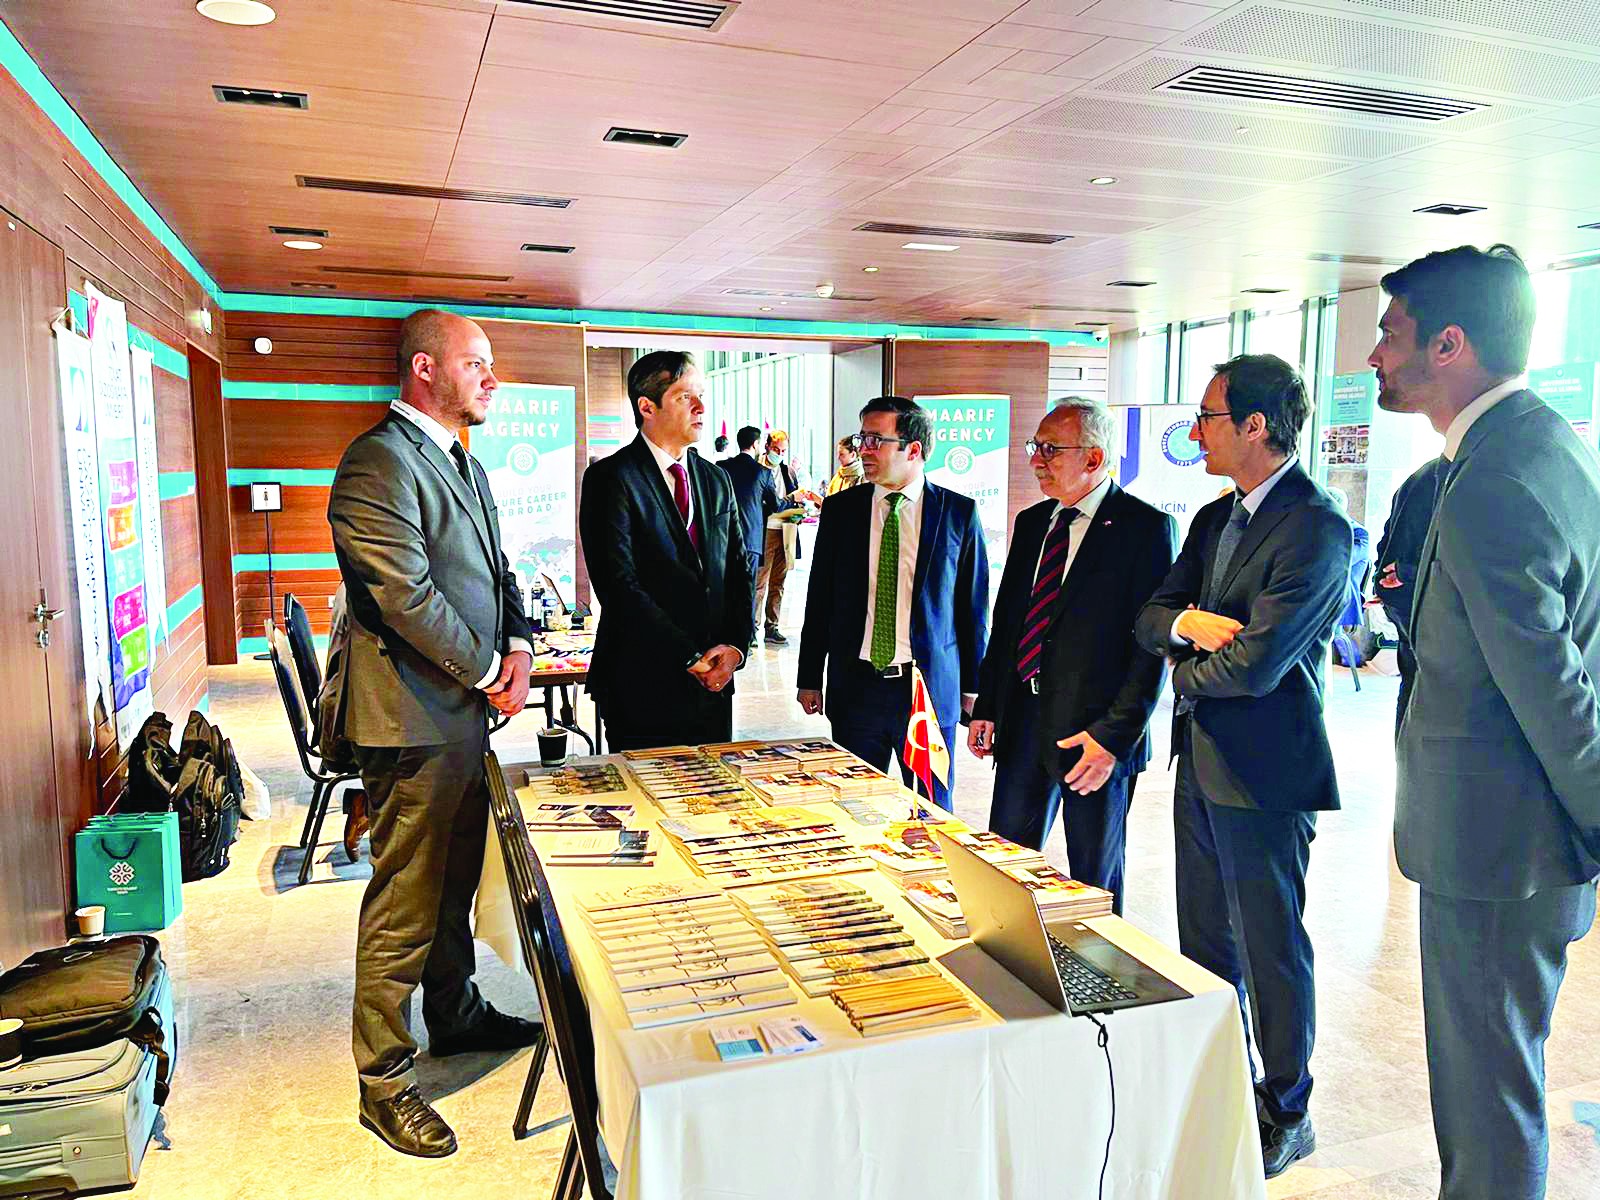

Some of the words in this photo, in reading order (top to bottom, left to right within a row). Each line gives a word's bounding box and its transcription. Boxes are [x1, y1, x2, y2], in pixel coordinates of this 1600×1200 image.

[482, 421, 560, 438] AGENCY
[936, 428, 995, 442] GENCY
[527, 492, 567, 504] CAREER
[499, 504, 552, 517] ABROAD
